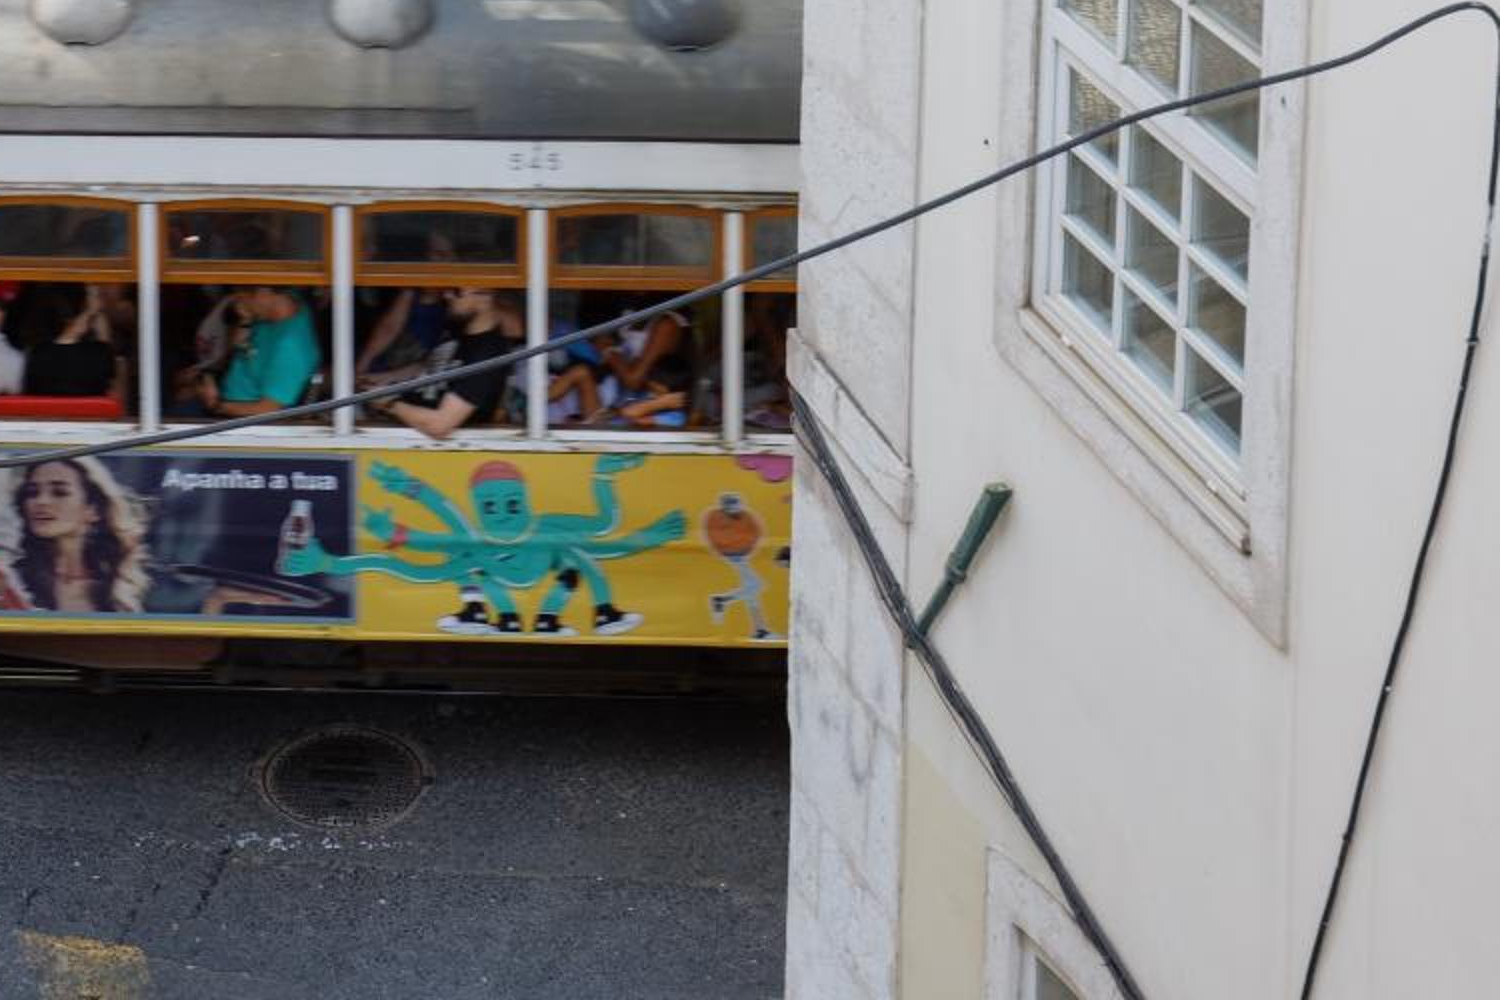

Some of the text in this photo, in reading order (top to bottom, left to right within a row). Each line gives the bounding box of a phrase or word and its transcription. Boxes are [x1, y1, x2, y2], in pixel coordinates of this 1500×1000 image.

[161, 468, 339, 491] Apanha a tua
